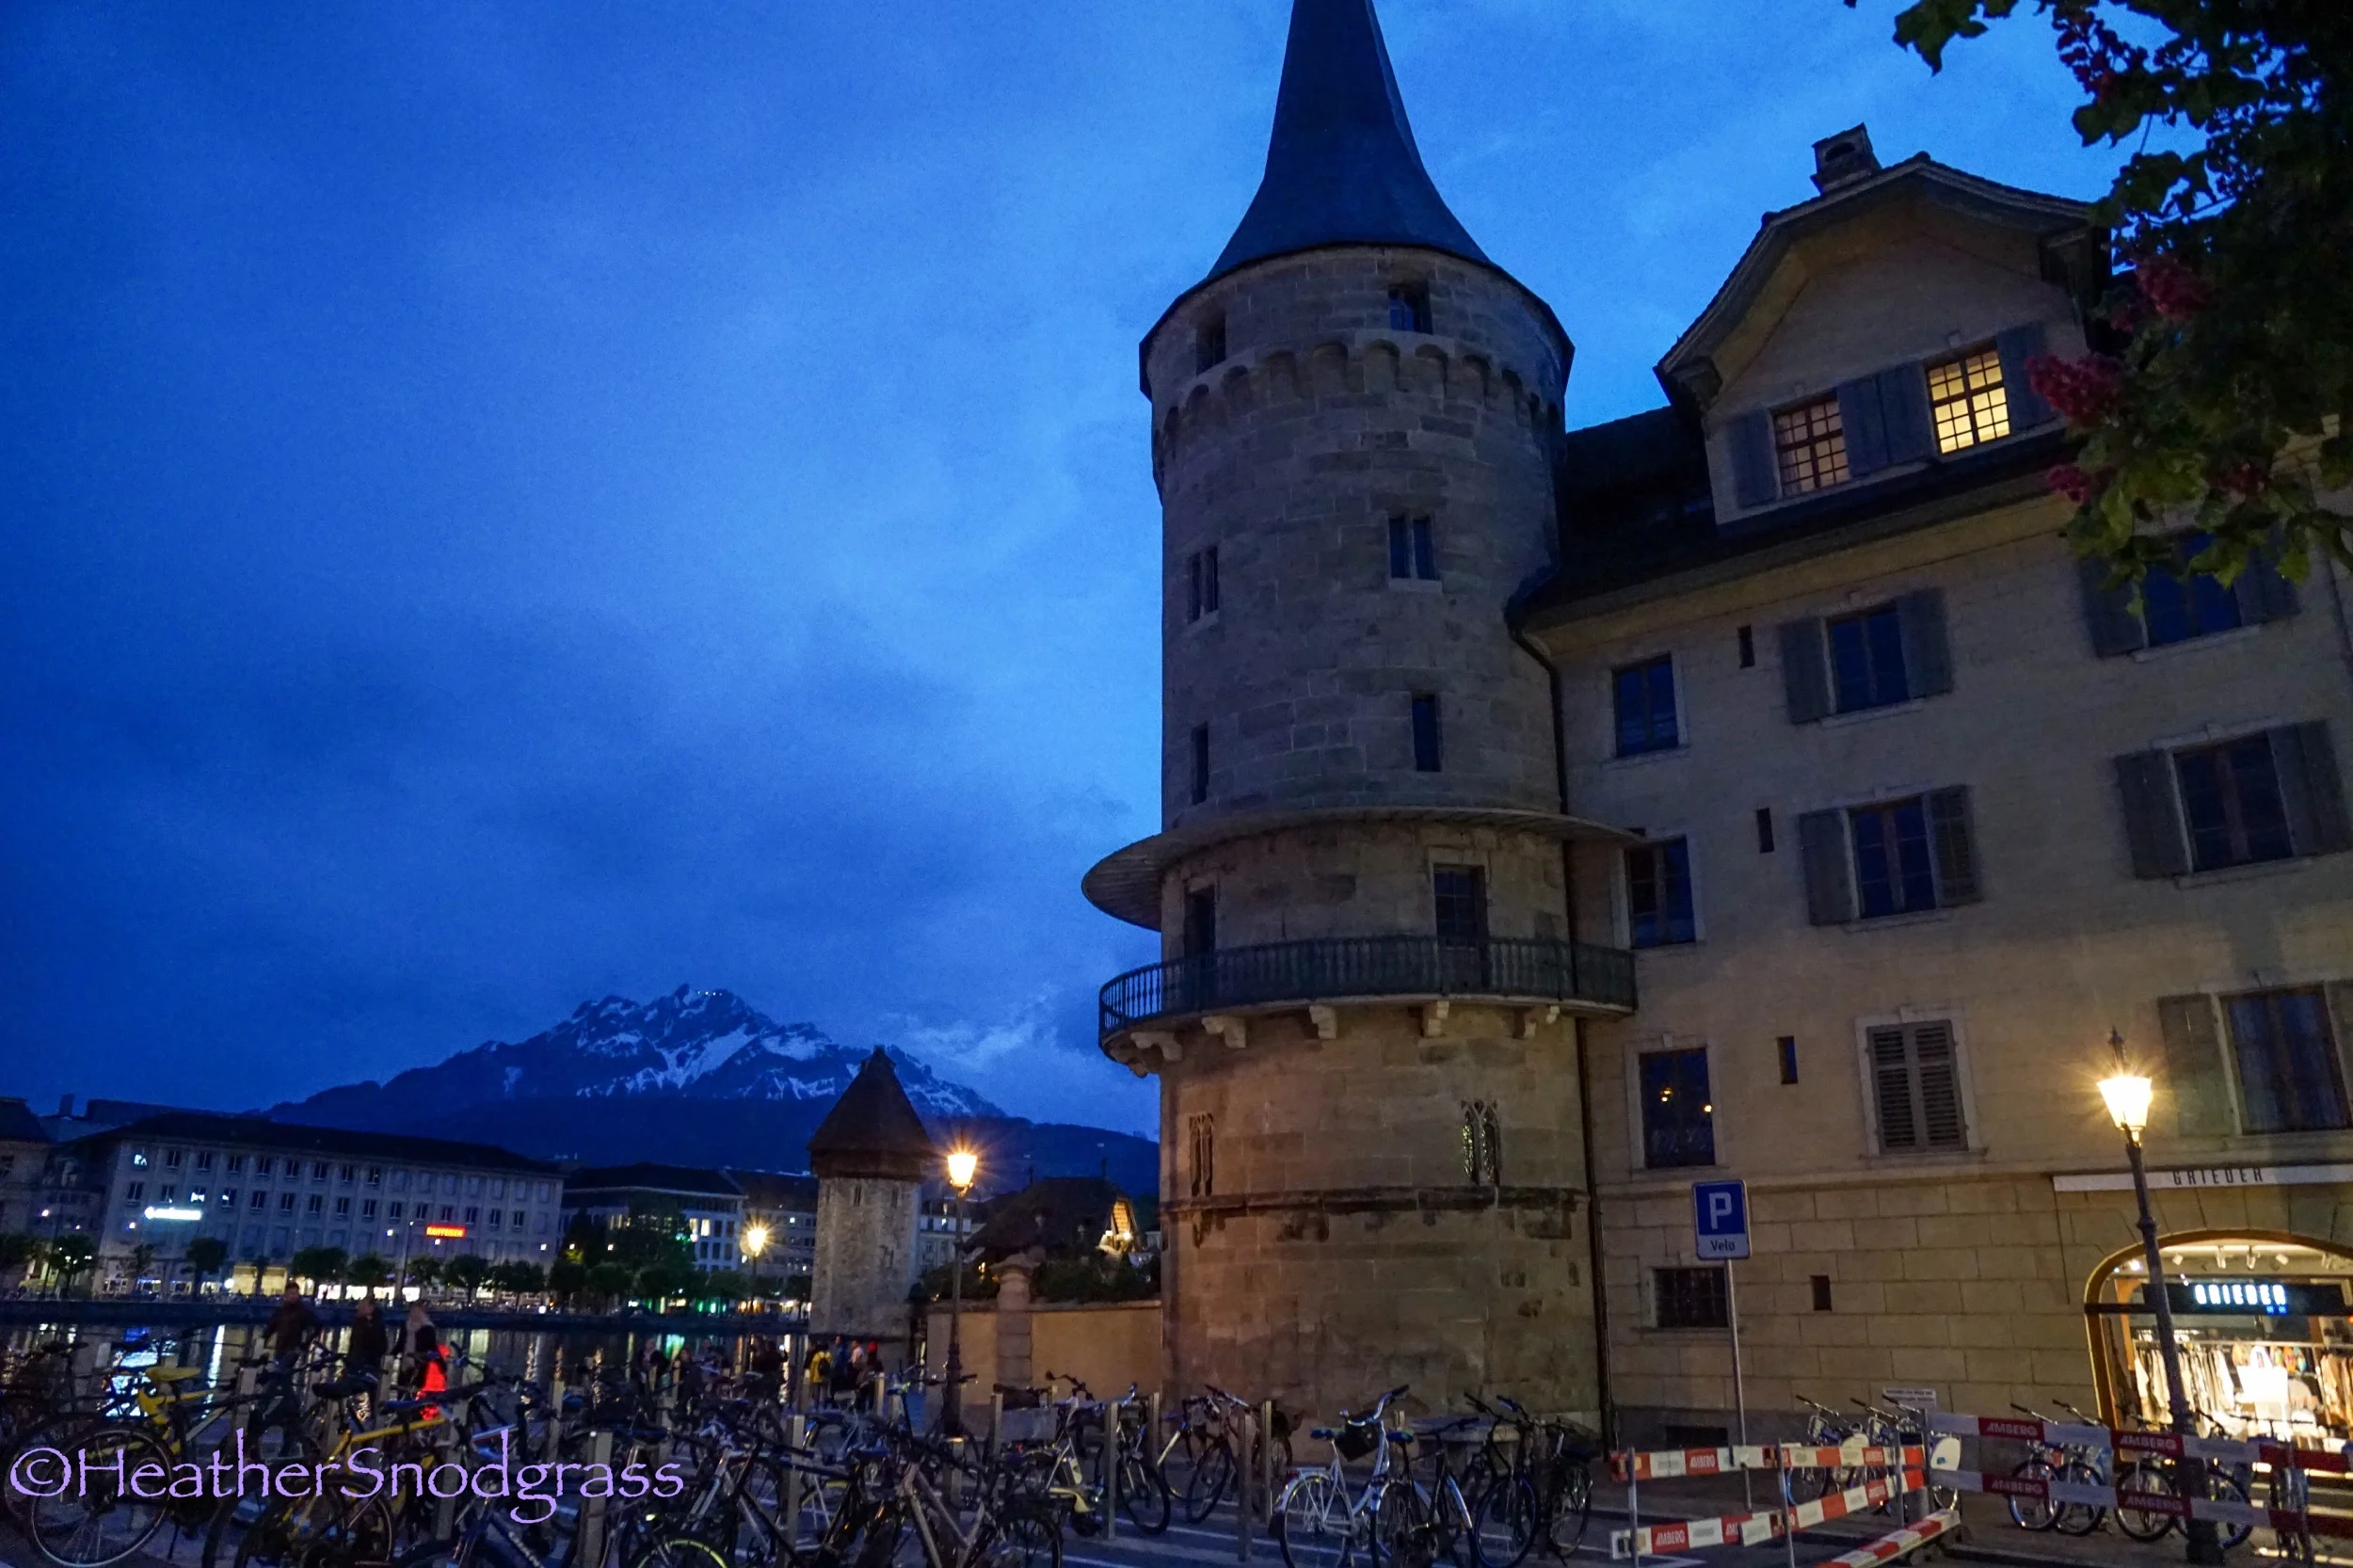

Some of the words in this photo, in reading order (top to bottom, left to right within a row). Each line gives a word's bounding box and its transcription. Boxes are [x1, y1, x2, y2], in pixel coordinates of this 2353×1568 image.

[2172, 1167, 2264, 1186] GRIEDER
[1708, 1192, 1733, 1230] P
[1710, 1239, 1736, 1252] Velo
[2194, 1284, 2286, 1305] GRIEDER
[1987, 1422, 2039, 1437] AMBERG
[2120, 1434, 2178, 1450] AMBERG
[1689, 1455, 1716, 1468] AMBERG
[1991, 1479, 2043, 1495] AMBERG
[1655, 1529, 1686, 1545] AMBERG
